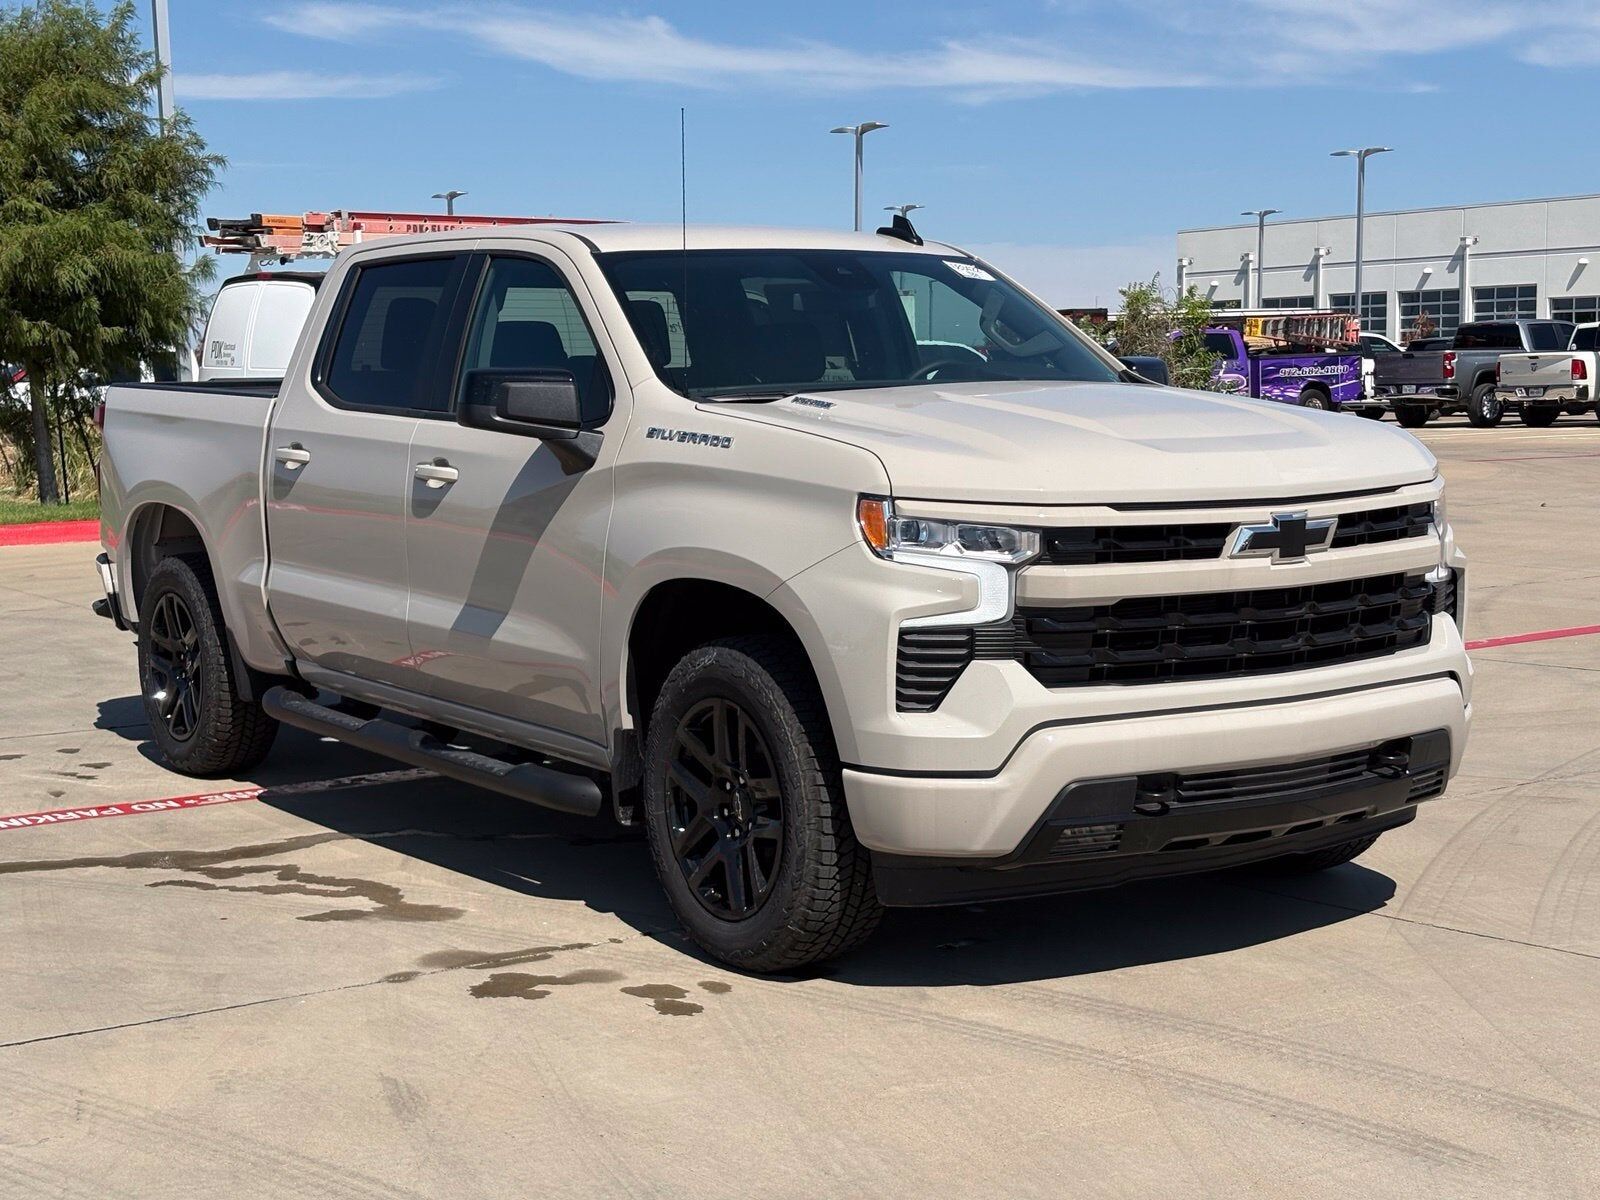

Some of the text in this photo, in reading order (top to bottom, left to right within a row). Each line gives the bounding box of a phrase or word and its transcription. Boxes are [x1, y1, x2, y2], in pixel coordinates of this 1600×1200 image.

[211, 340, 224, 359] PDK
[646, 427, 734, 449] SILVERADO
[0, 789, 266, 828] ANE NO PARKIN
